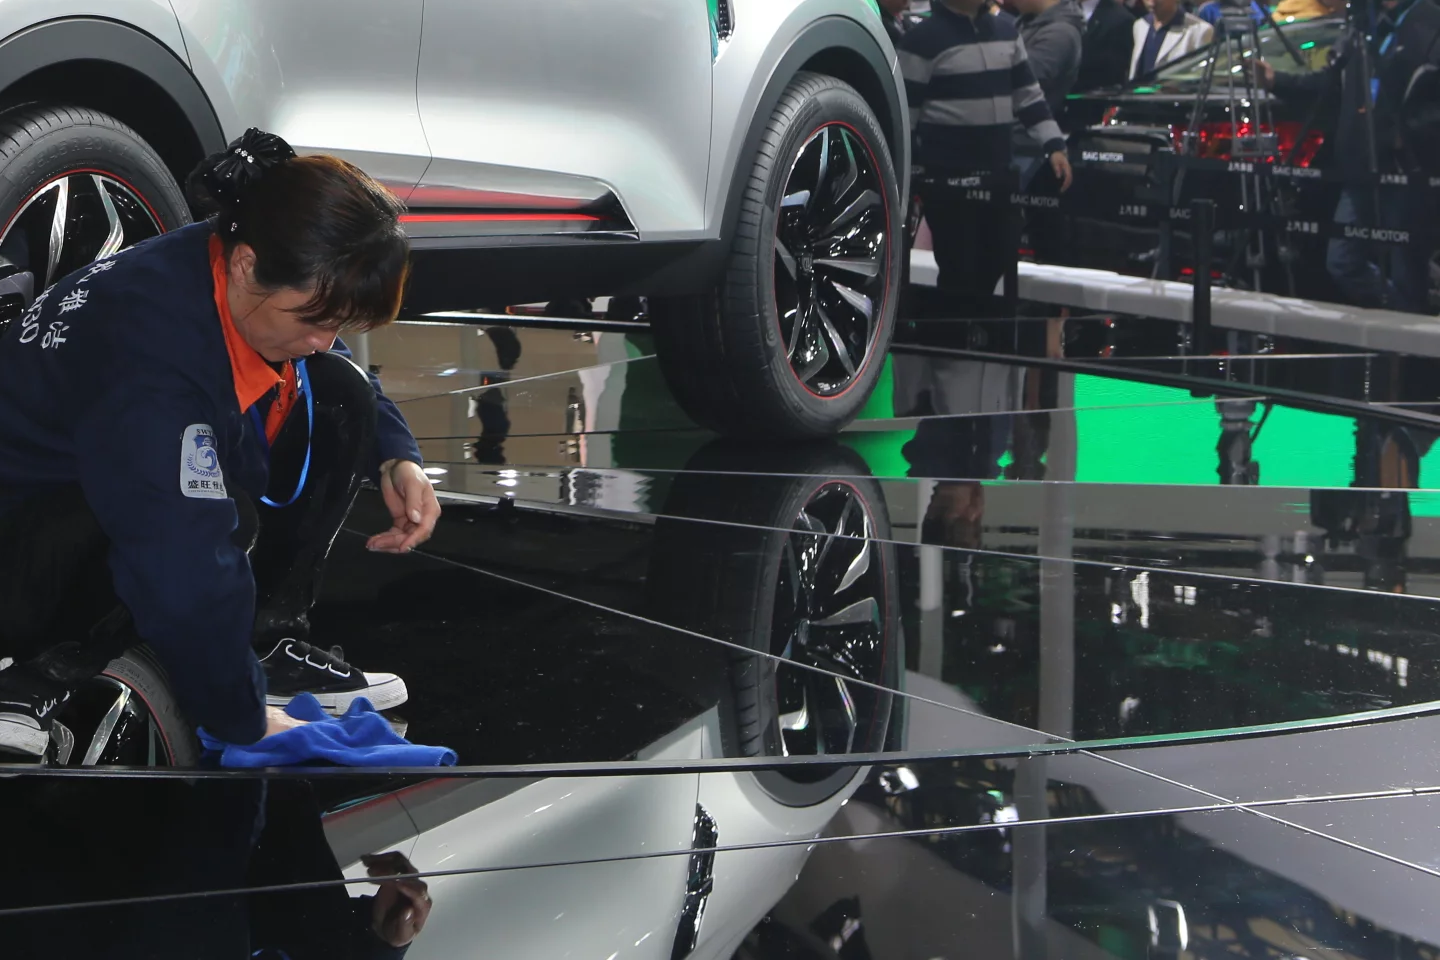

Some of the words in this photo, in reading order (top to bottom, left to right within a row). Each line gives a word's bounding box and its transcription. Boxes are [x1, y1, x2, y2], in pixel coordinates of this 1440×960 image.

[1082, 151, 1098, 161] SAIC
[1099, 152, 1124, 162] MOTOR
[1271, 165, 1291, 176] SAIC
[1292, 167, 1321, 179] MOTOR
[1010, 194, 1029, 205] SAIC
[1030, 196, 1060, 208] MOTOR
[1169, 207, 1191, 219] SAIC
[1344, 226, 1369, 239] SAIC
[1372, 229, 1410, 244] MOTOR
